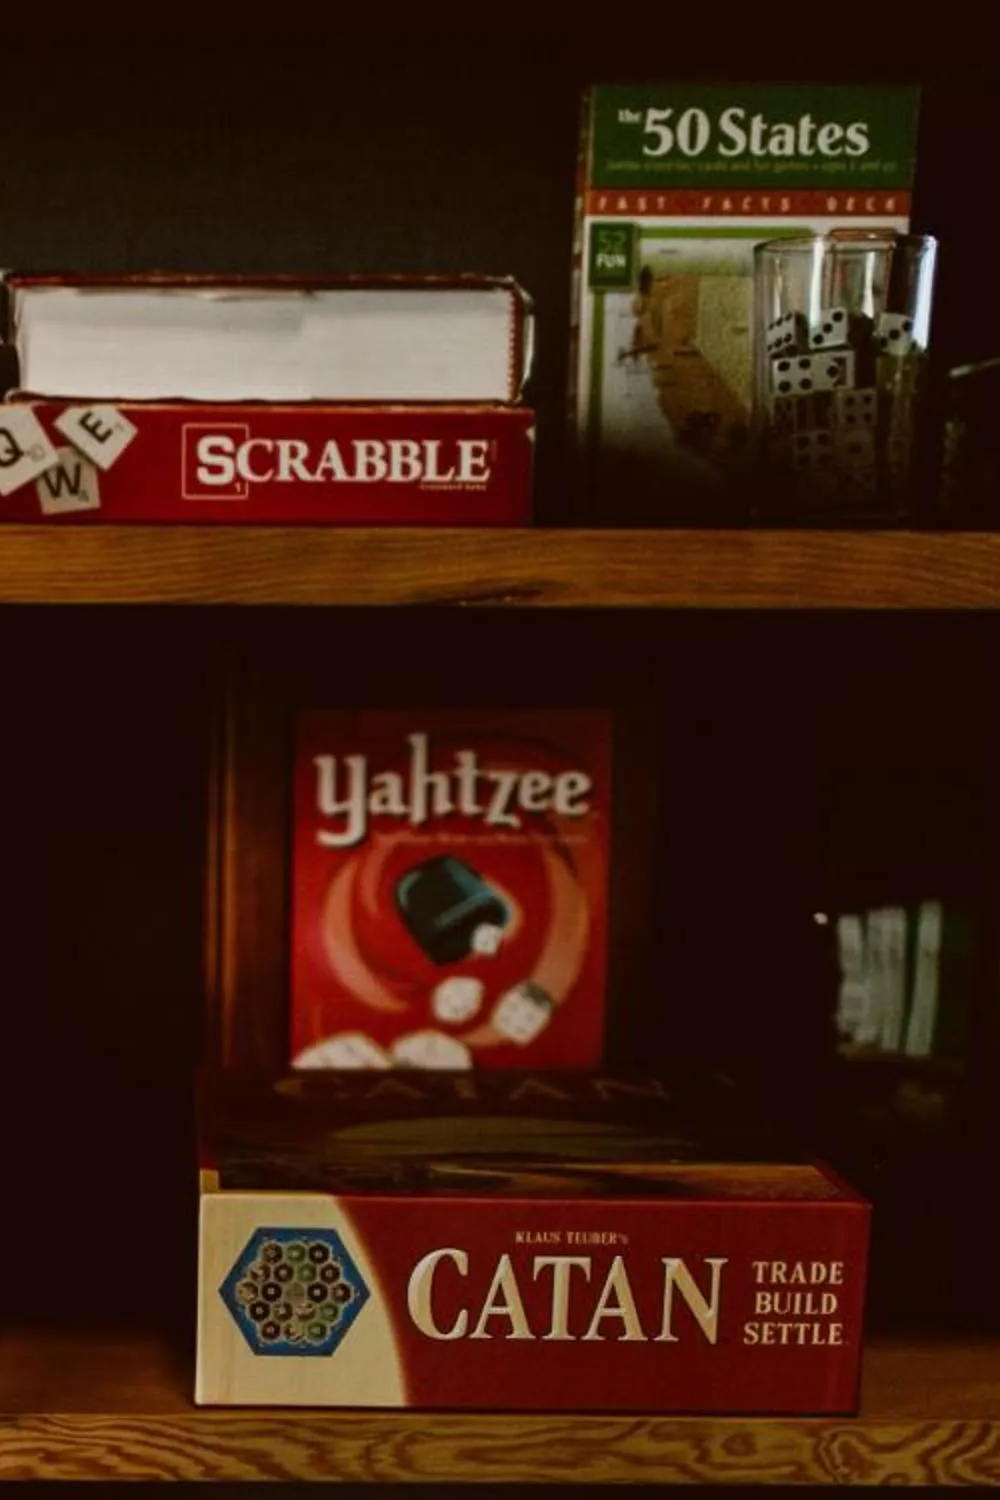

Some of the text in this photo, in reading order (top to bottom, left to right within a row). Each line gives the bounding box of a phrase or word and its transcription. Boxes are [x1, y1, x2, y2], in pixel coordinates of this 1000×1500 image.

[617, 107, 871, 157] the 50 States
[599, 196, 897, 212] FAST FACTS DECK
[596, 252, 626, 269] FUN
[196, 434, 492, 487] SCRABBLE
[515, 1230, 562, 1246] KLAUS
[751, 1260, 845, 1286] TRADE
[406, 1246, 730, 1346] CATAN
[753, 1291, 839, 1316] BUILD
[742, 1321, 846, 1347] SETTLE
